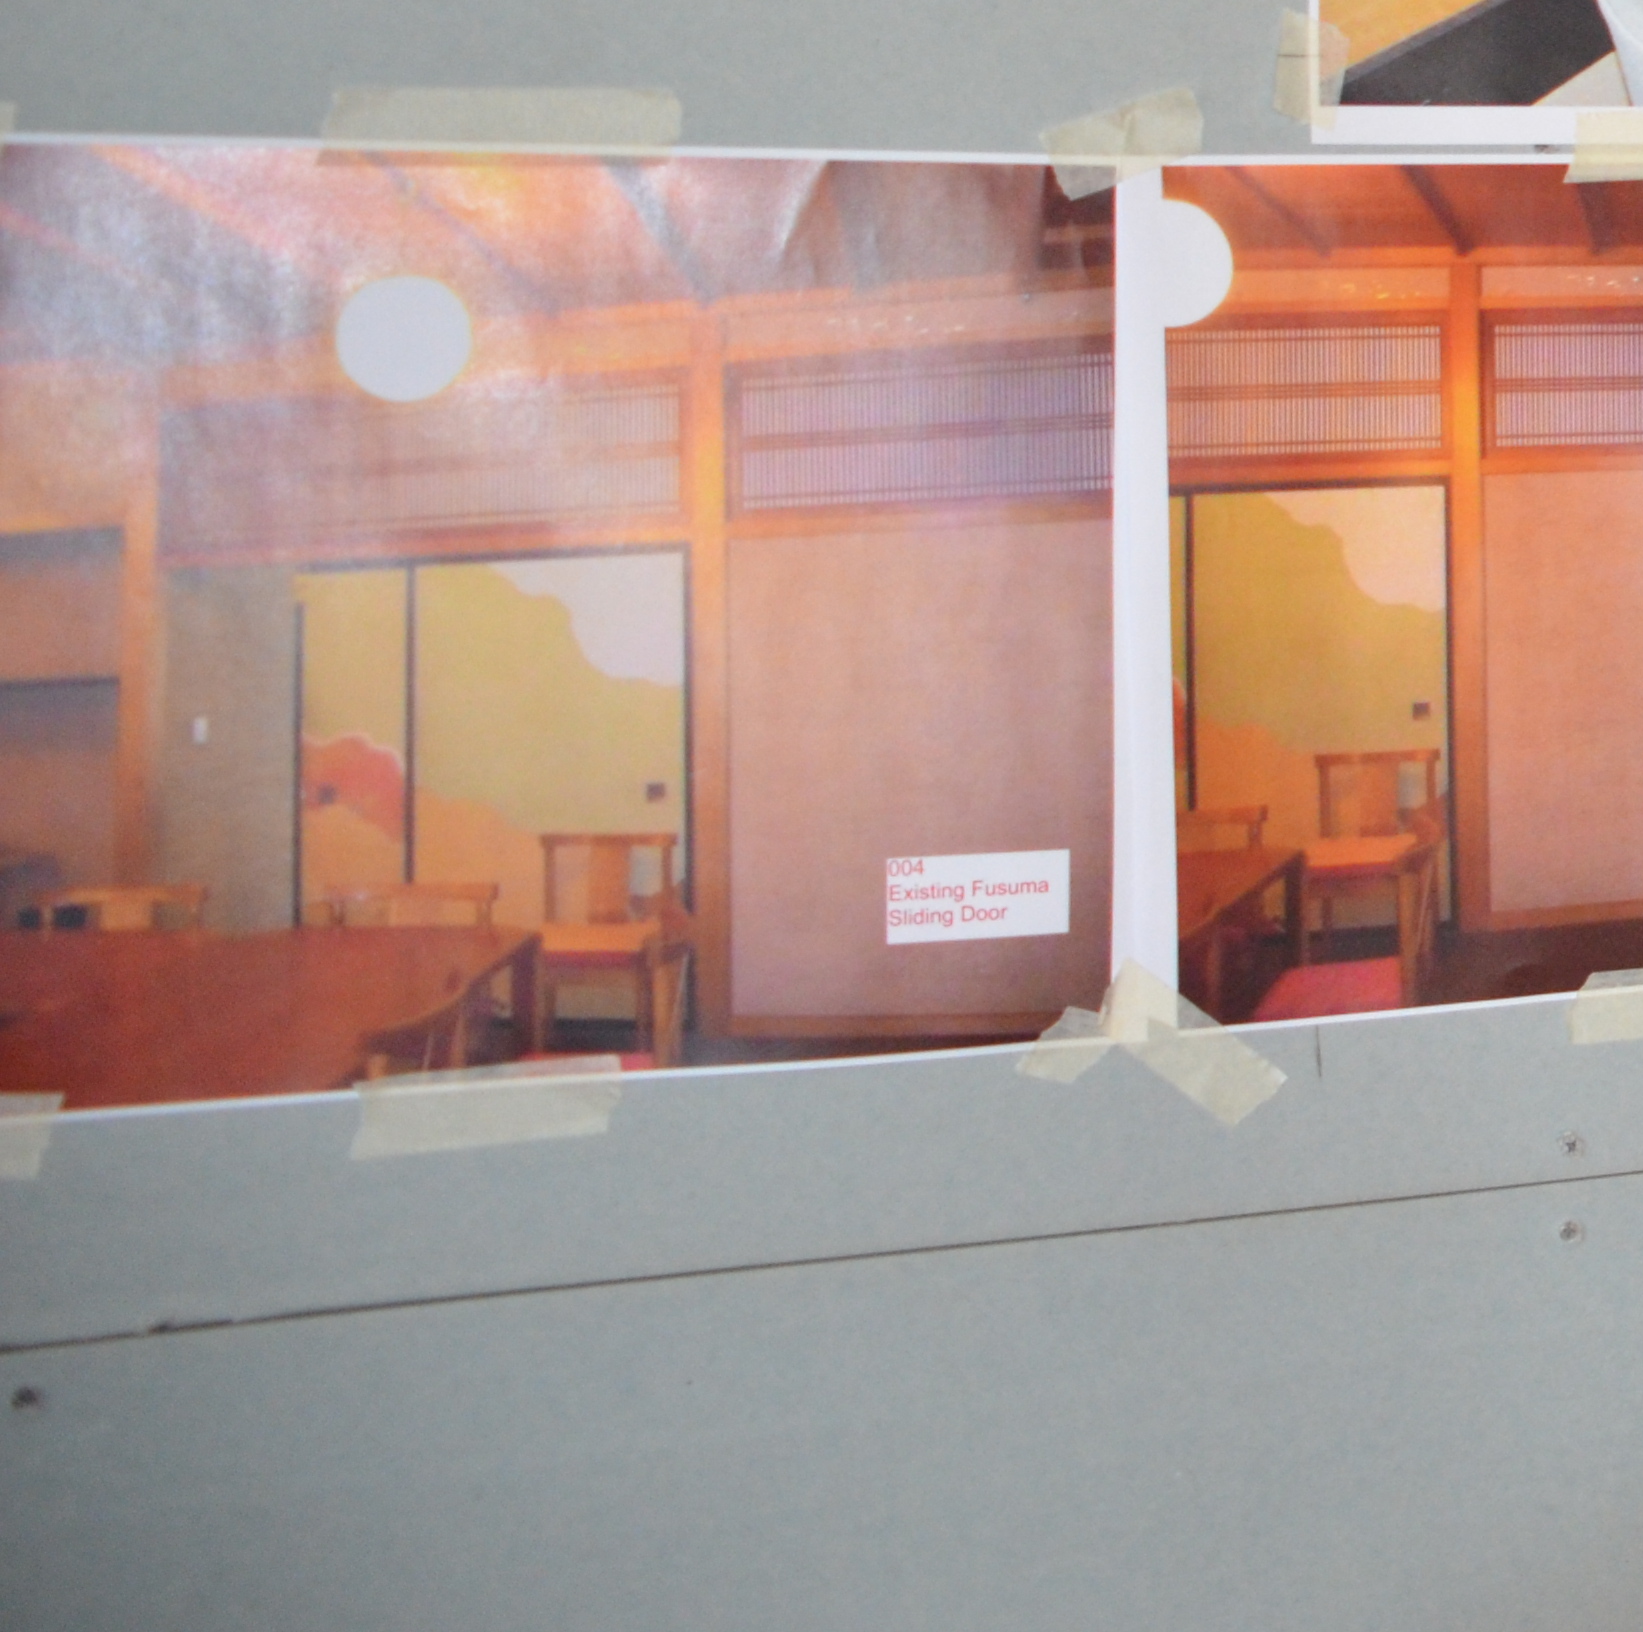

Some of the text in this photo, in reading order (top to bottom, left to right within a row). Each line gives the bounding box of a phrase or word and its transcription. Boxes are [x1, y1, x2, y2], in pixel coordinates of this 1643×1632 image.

[888, 860, 924, 876] 004
[889, 880, 1049, 902] Existing Fusuma
[889, 905, 1008, 927] Sliding Door
